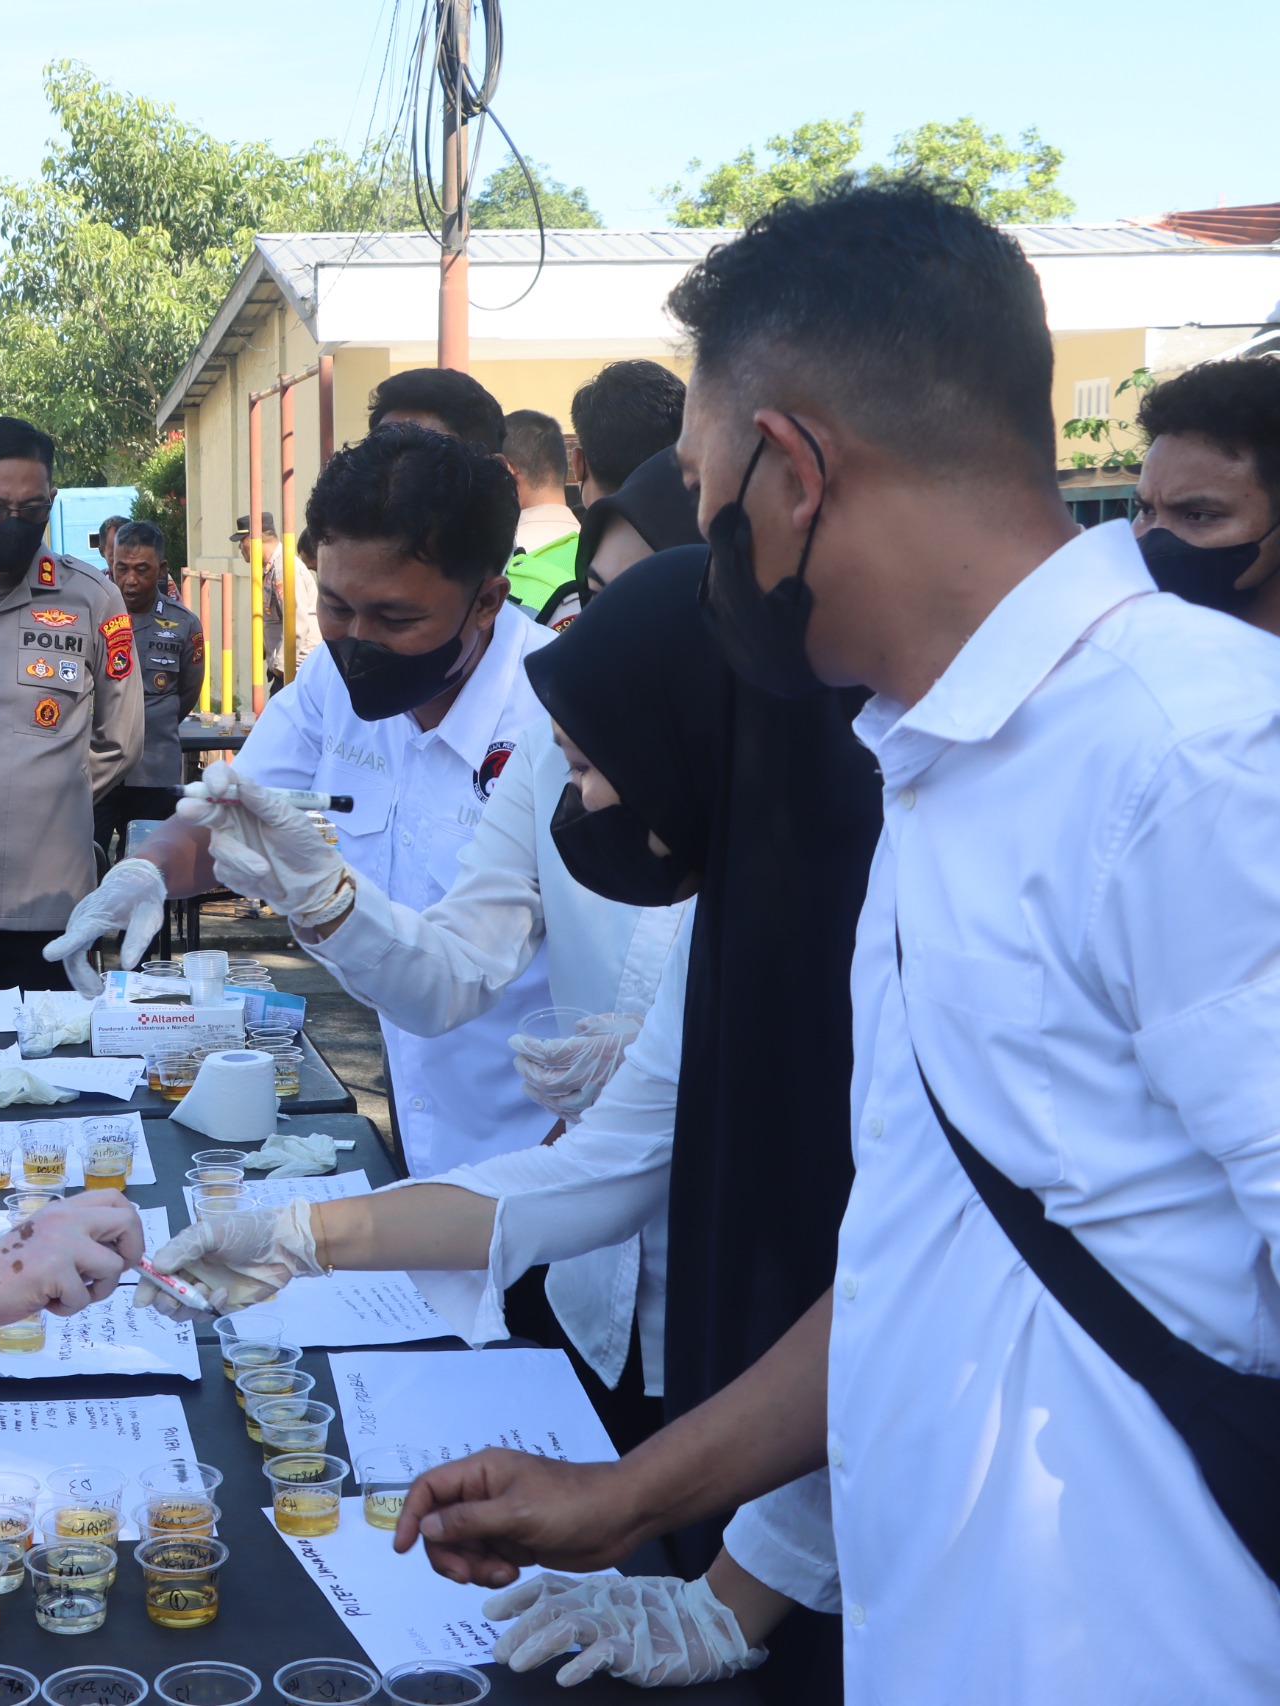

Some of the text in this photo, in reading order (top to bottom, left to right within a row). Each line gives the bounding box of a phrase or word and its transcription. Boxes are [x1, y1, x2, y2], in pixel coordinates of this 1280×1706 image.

[23, 631, 83, 653] POLRI
[148, 641, 180, 652] POLRI
[325, 735, 387, 774] BAHAR
[151, 1014, 195, 1024] Altamed
